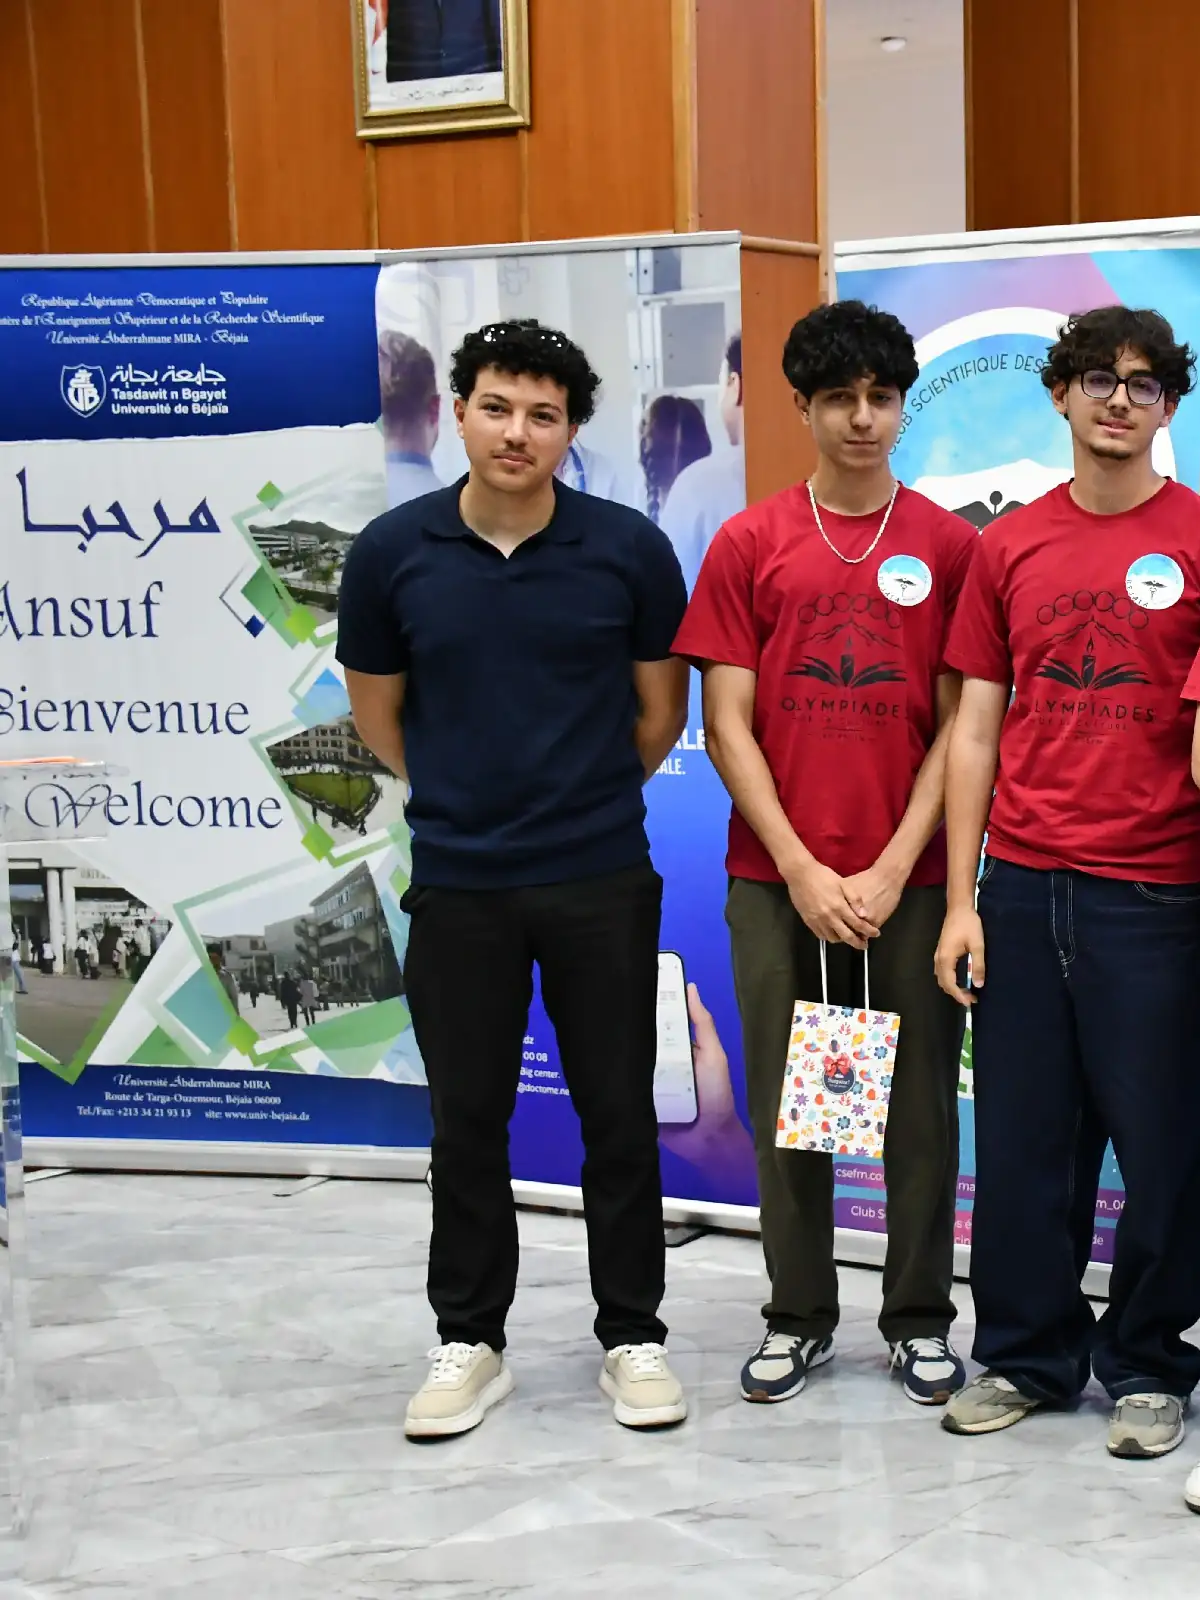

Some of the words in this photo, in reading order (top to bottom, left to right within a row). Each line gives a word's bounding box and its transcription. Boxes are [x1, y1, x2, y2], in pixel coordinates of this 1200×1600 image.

[207, 295, 217, 305] et
[220, 290, 269, 307] Populaire
[22, 315, 33, 326] de
[169, 315, 179, 325] et
[181, 314, 191, 325] de
[193, 313, 202, 325] la
[203, 311, 258, 325] Recherche
[261, 309, 325, 326] Scientifique
[46, 330, 100, 344] Université
[101, 330, 172, 344] Abderrahmane
[174, 334, 201, 344] MIRA
[110, 362, 158, 388] بجاية
[161, 362, 226, 386] جامعة
[911, 354, 1008, 412] SCIENTIFIQUE
[111, 388, 168, 400] Tasdawit
[171, 389, 179, 400] n
[181, 388, 227, 402] Bgayet
[111, 403, 171, 415] Université
[174, 403, 189, 414] de
[16, 467, 221, 558] مرحبا
[1034, 700, 1157, 723] LYMPIADES
[24, 781, 284, 829] Welcome
[113, 1073, 168, 1088] Université
[169, 1075, 240, 1089] Abderrahmane
[243, 1080, 271, 1090] MIRA
[104, 1091, 131, 1102] Route
[133, 1091, 144, 1102] de
[835, 1168, 885, 1182] csefm.co
[851, 1205, 876, 1218] Club
